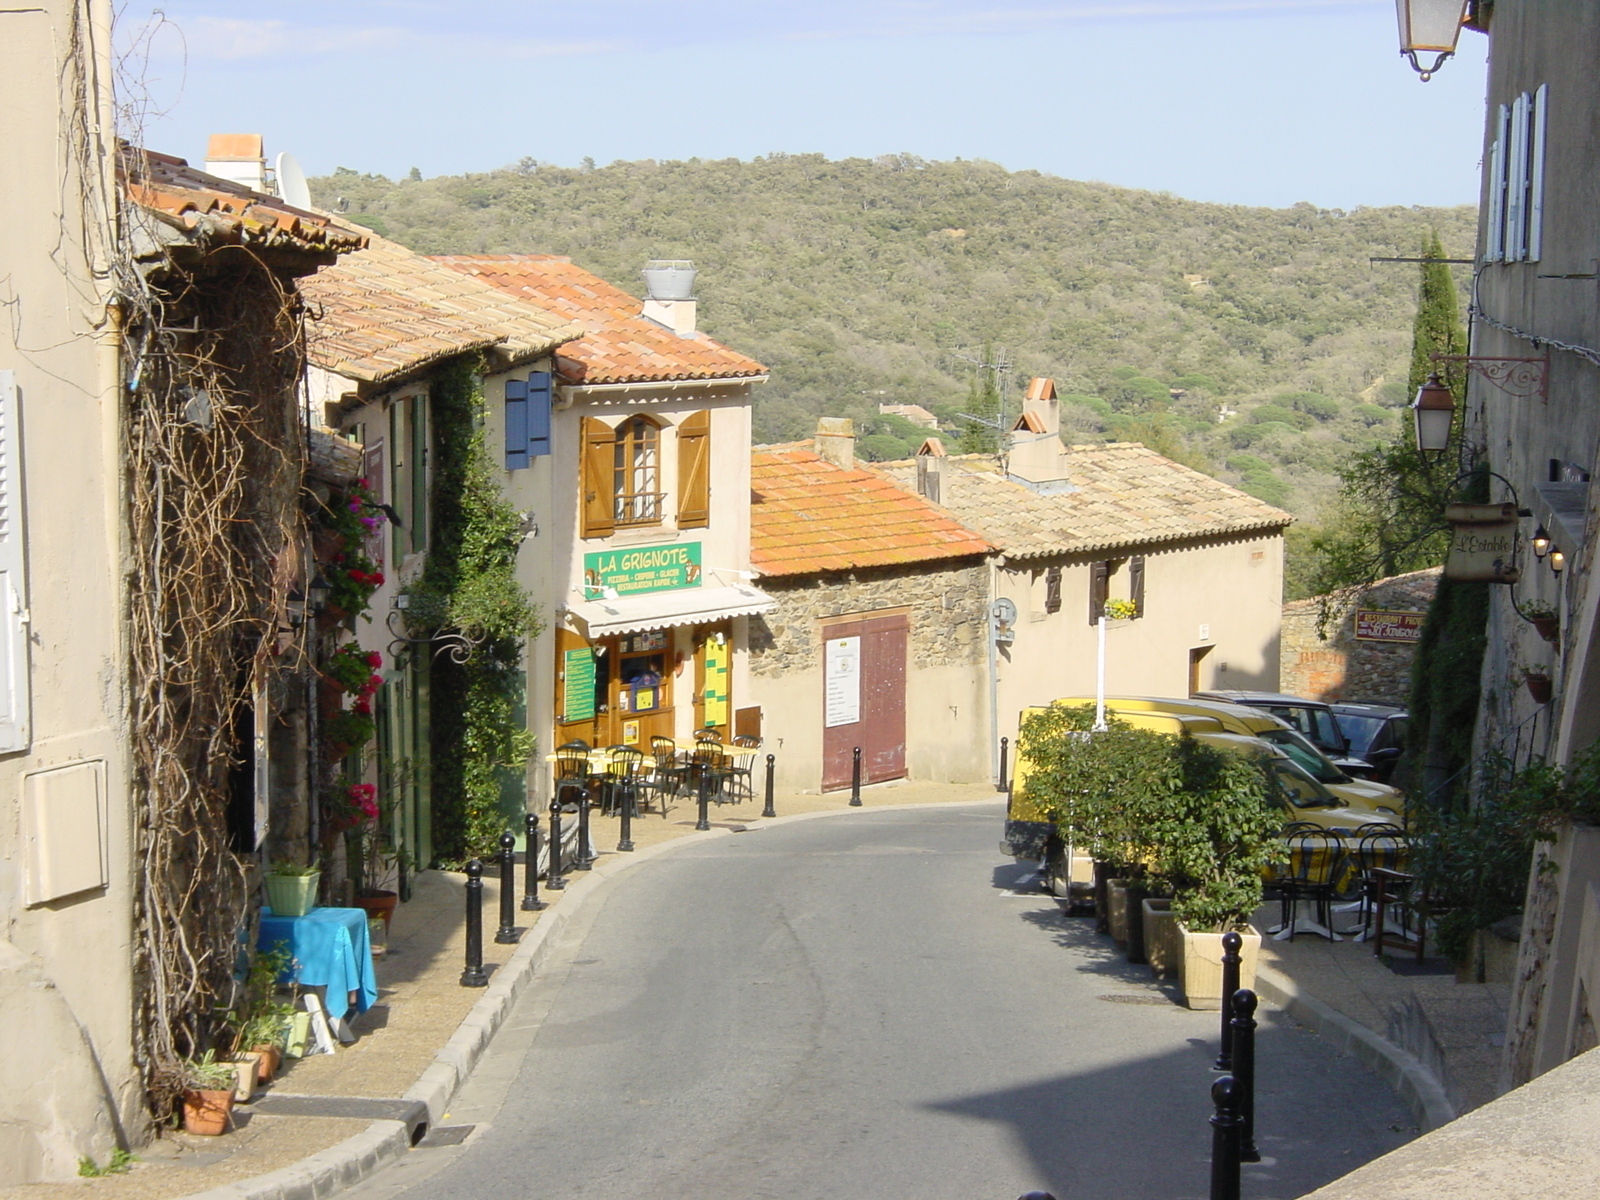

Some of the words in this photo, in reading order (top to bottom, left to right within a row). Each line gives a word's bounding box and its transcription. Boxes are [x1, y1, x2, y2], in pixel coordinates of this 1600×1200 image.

[598, 555, 617, 574] LA
[621, 547, 688, 571] GRIGNOTE
[1364, 614, 1402, 624] RESTAURANT
